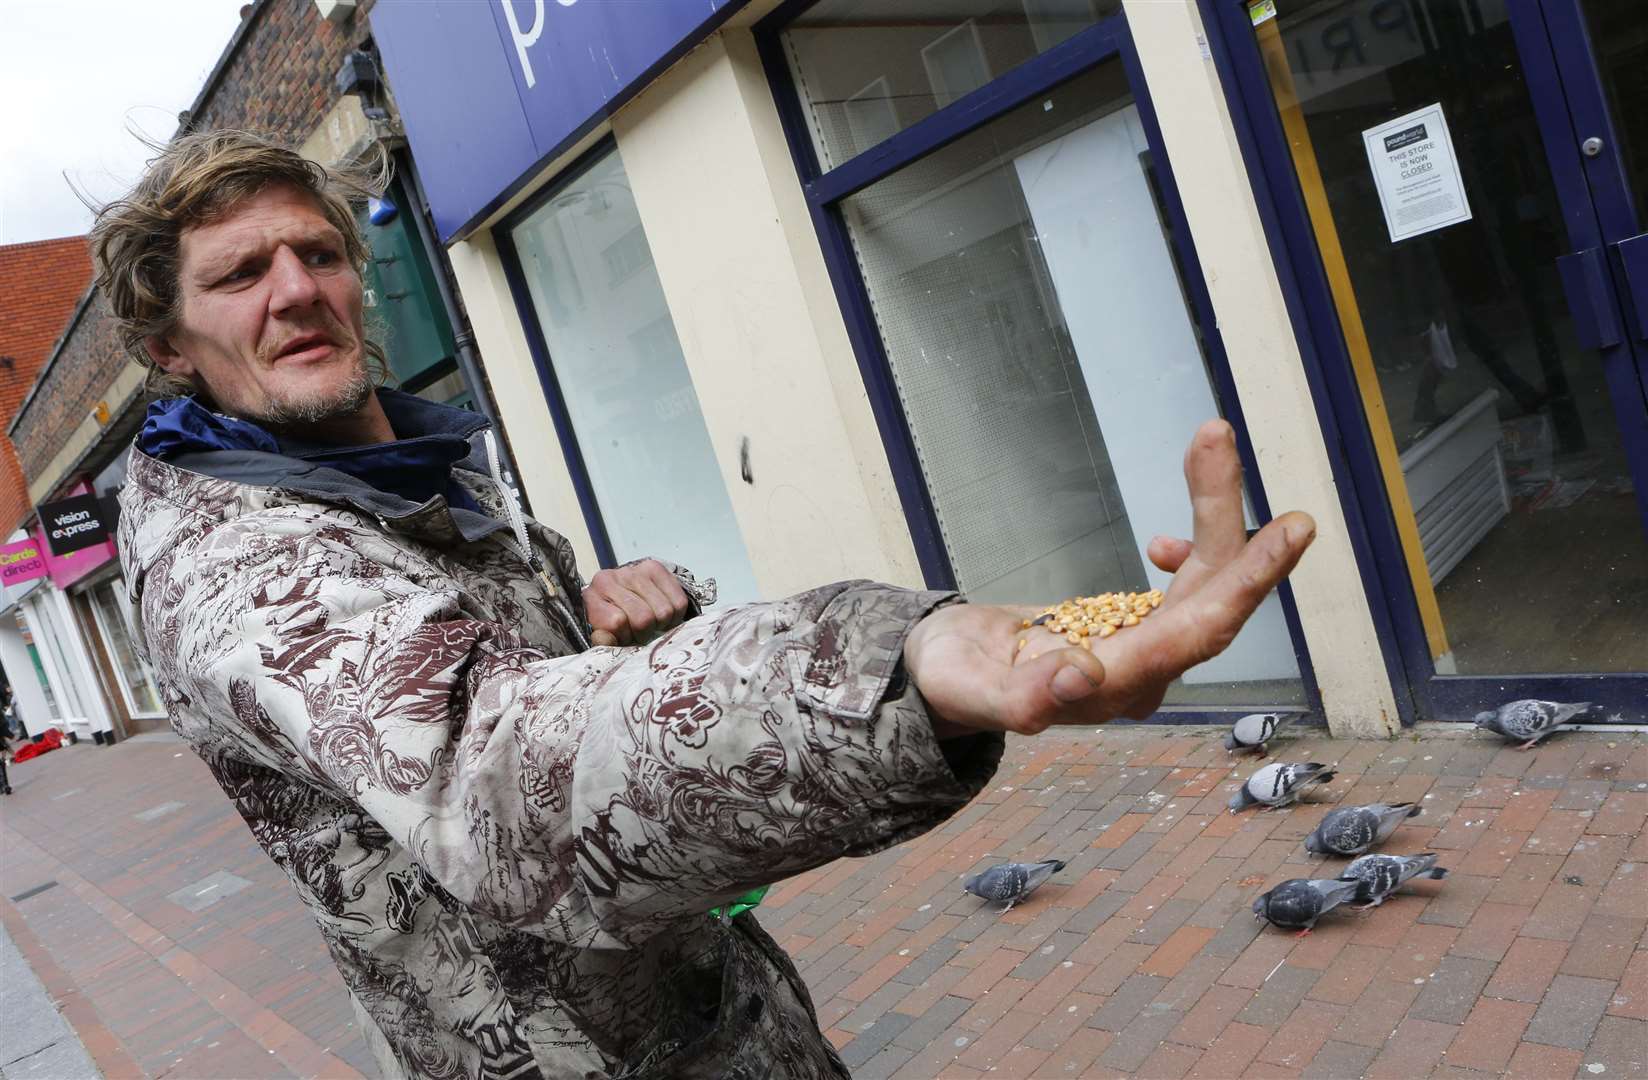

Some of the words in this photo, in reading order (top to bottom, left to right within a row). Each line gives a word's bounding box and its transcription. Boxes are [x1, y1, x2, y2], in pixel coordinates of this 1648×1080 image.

[1389, 151, 1407, 163] THIS
[1408, 141, 1435, 156] STORE
[1400, 160, 1408, 169] IS
[1409, 153, 1428, 166] NOW
[1400, 162, 1433, 178] CLOSED
[54, 510, 90, 526] vision
[52, 518, 100, 539] express
[4, 560, 41, 577] direct
